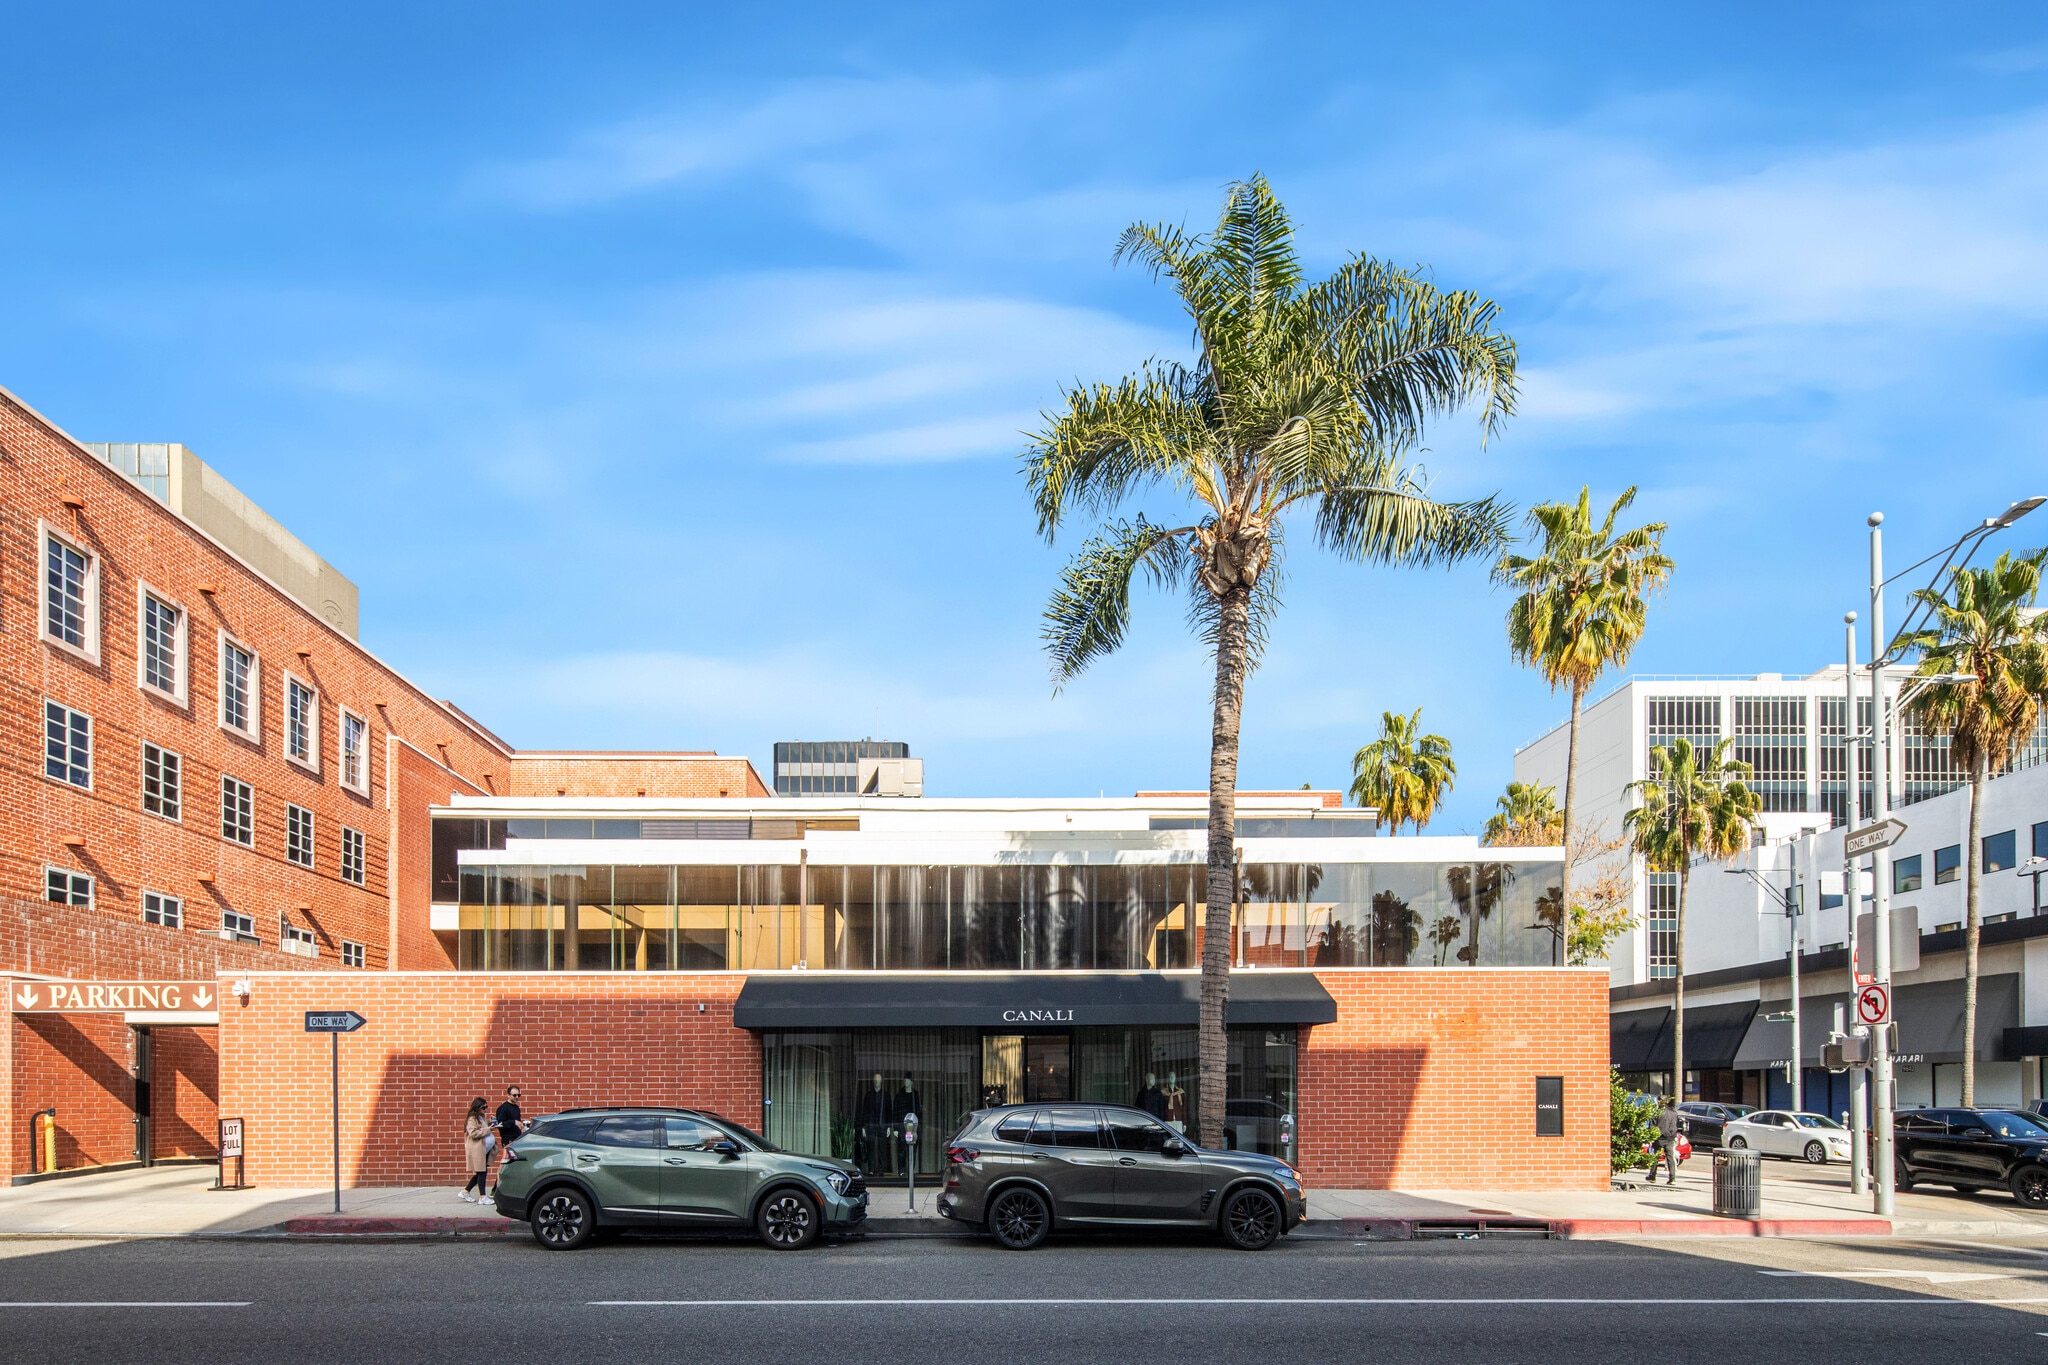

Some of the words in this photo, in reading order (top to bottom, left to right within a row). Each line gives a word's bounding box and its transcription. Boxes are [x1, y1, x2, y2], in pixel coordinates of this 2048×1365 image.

[1849, 837, 1865, 851] ONE
[1868, 830, 1885, 844] WAY
[48, 984, 182, 1009] PARKING
[311, 1017, 328, 1026] ONE
[331, 1017, 349, 1026] WAY
[1003, 1009, 1075, 1022] CANALI
[224, 1126, 238, 1136] LOT
[222, 1139, 240, 1150] FULL
